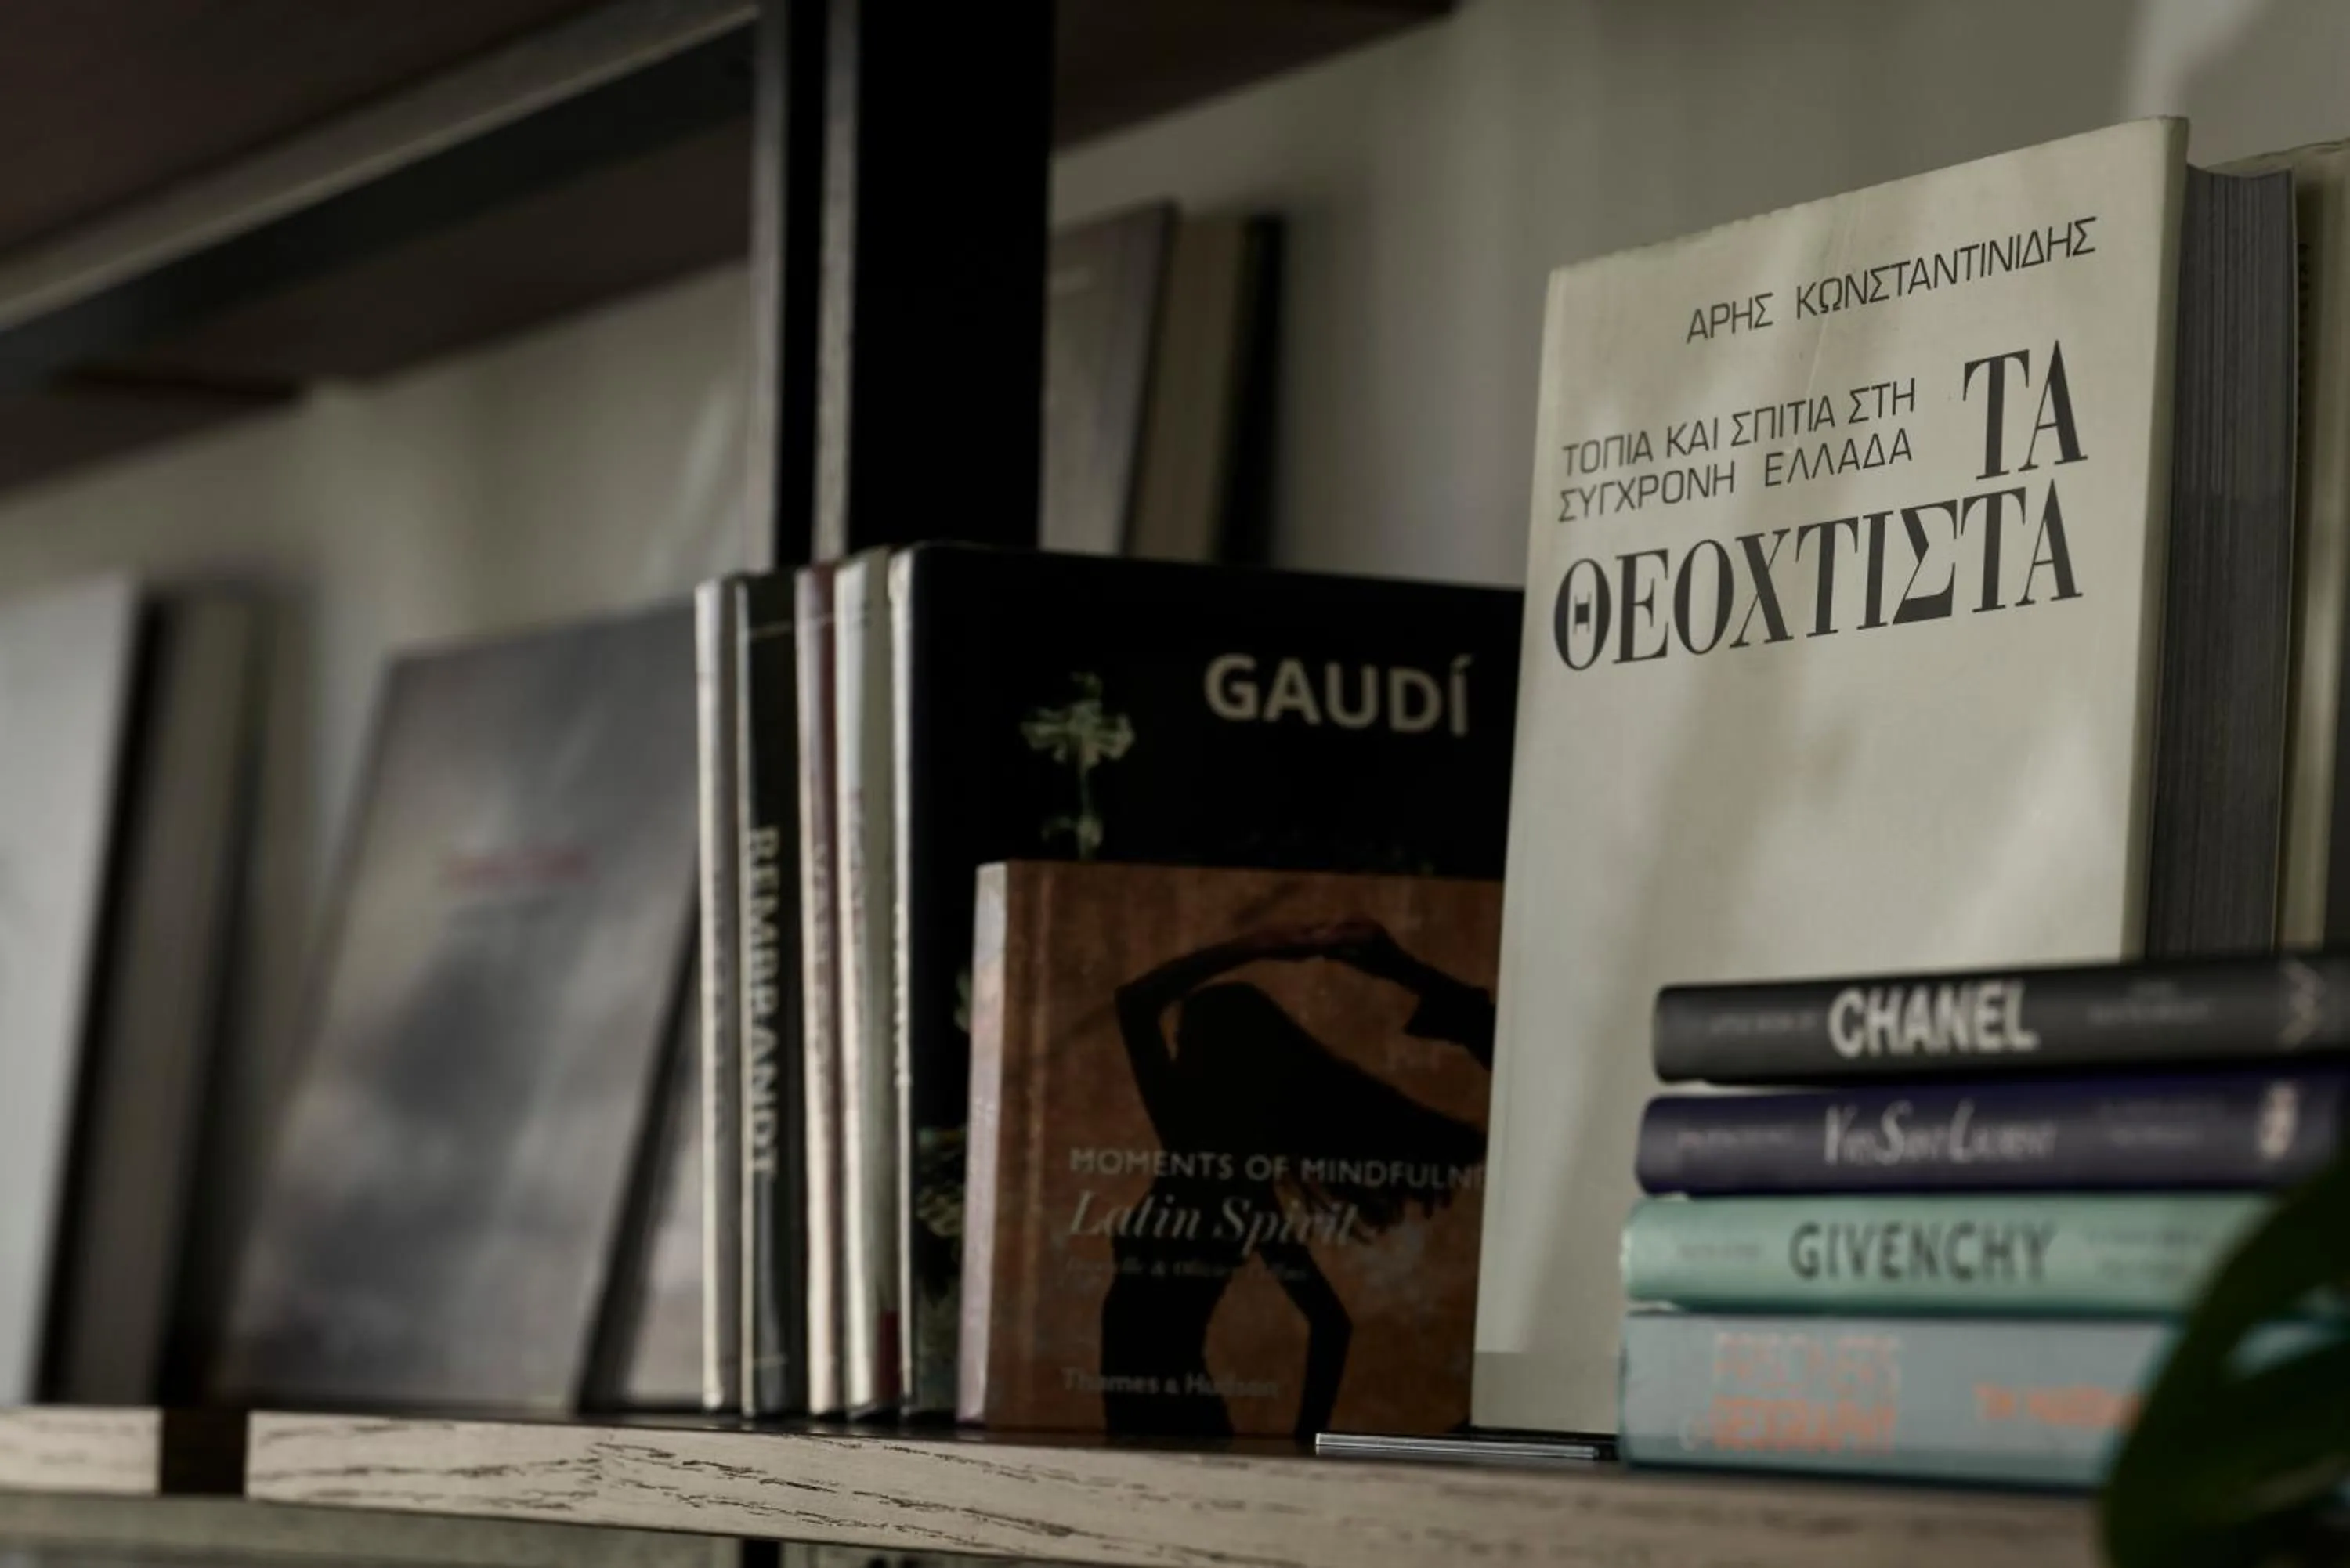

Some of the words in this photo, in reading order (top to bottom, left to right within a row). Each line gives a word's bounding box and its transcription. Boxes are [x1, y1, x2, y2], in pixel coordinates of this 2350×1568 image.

[1686, 292, 1774, 345] ΑΡΗΣ
[1795, 216, 2098, 320] ΚΩΝΣΤΑΝΤΙΝΙΔΗΣ
[1562, 430, 1654, 477] ΤΟΠΙΑ
[1665, 416, 1719, 459] ΚΑΙ
[1730, 395, 1836, 447] ΣΠΙΤΙΑ
[1847, 377, 1917, 425] ΣΤΗ
[1962, 339, 2089, 481] ΤΑ
[1557, 461, 1736, 523] ΣΥΓΧΡΟΝΗ
[1763, 427, 1913, 488] ΕΛΛΑΔΑ
[1553, 478, 2084, 672] ΘΕΟΧΤΙΣΤΑ
[1202, 651, 1479, 740] GAUDÍ
[1826, 977, 2041, 1059] CHANEL
[1069, 1147, 1235, 1180] MOMENTS
[1244, 1152, 1290, 1182] OF
[1067, 1189, 1203, 1240] Latin
[1211, 1194, 1360, 1258] Spirit
[1788, 1219, 2057, 1281] GIVENCHY
